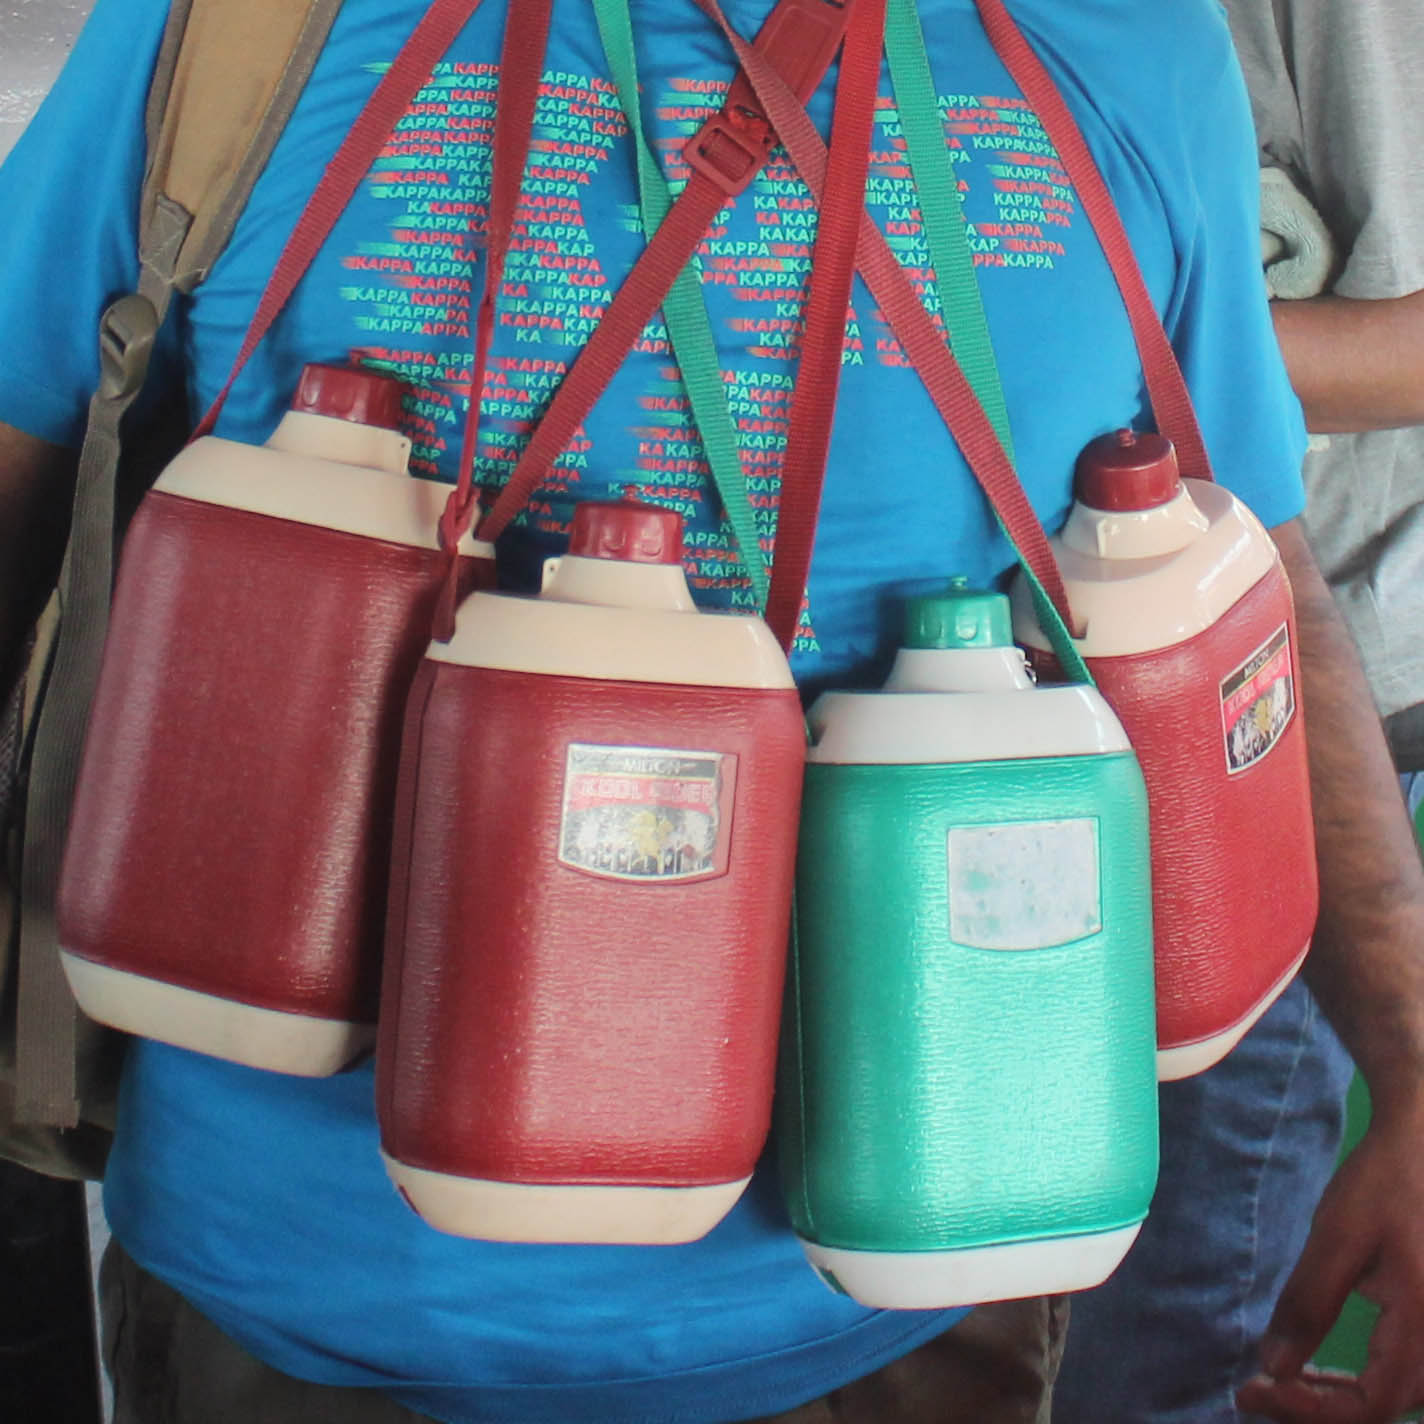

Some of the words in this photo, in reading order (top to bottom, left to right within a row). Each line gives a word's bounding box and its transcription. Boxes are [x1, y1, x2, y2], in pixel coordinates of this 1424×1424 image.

[558, 128, 615, 149] KAPPA
[550, 140, 609, 161] KAPPA
[541, 155, 598, 173] KAPPA
[395, 171, 449, 184] KAPPA
[521, 179, 579, 197] KAPPA
[520, 194, 581, 211] KAPPA
[522, 208, 585, 227] KAPPA
[407, 231, 464, 246] KAPPA
[356, 257, 413, 272] KAPPA
[415, 262, 473, 278] KAPPA
[416, 277, 472, 292] KAPPA
[739, 272, 799, 287] KAPPA
[355, 287, 409, 304] KAPPA
[502, 283, 528, 297] KA
[552, 286, 614, 304] KAPPA
[410, 292, 471, 308] KAPPA
[516, 329, 541, 342] KA
[505, 358, 566, 374] KAPPA
[643, 485, 703, 502] KAPPA
